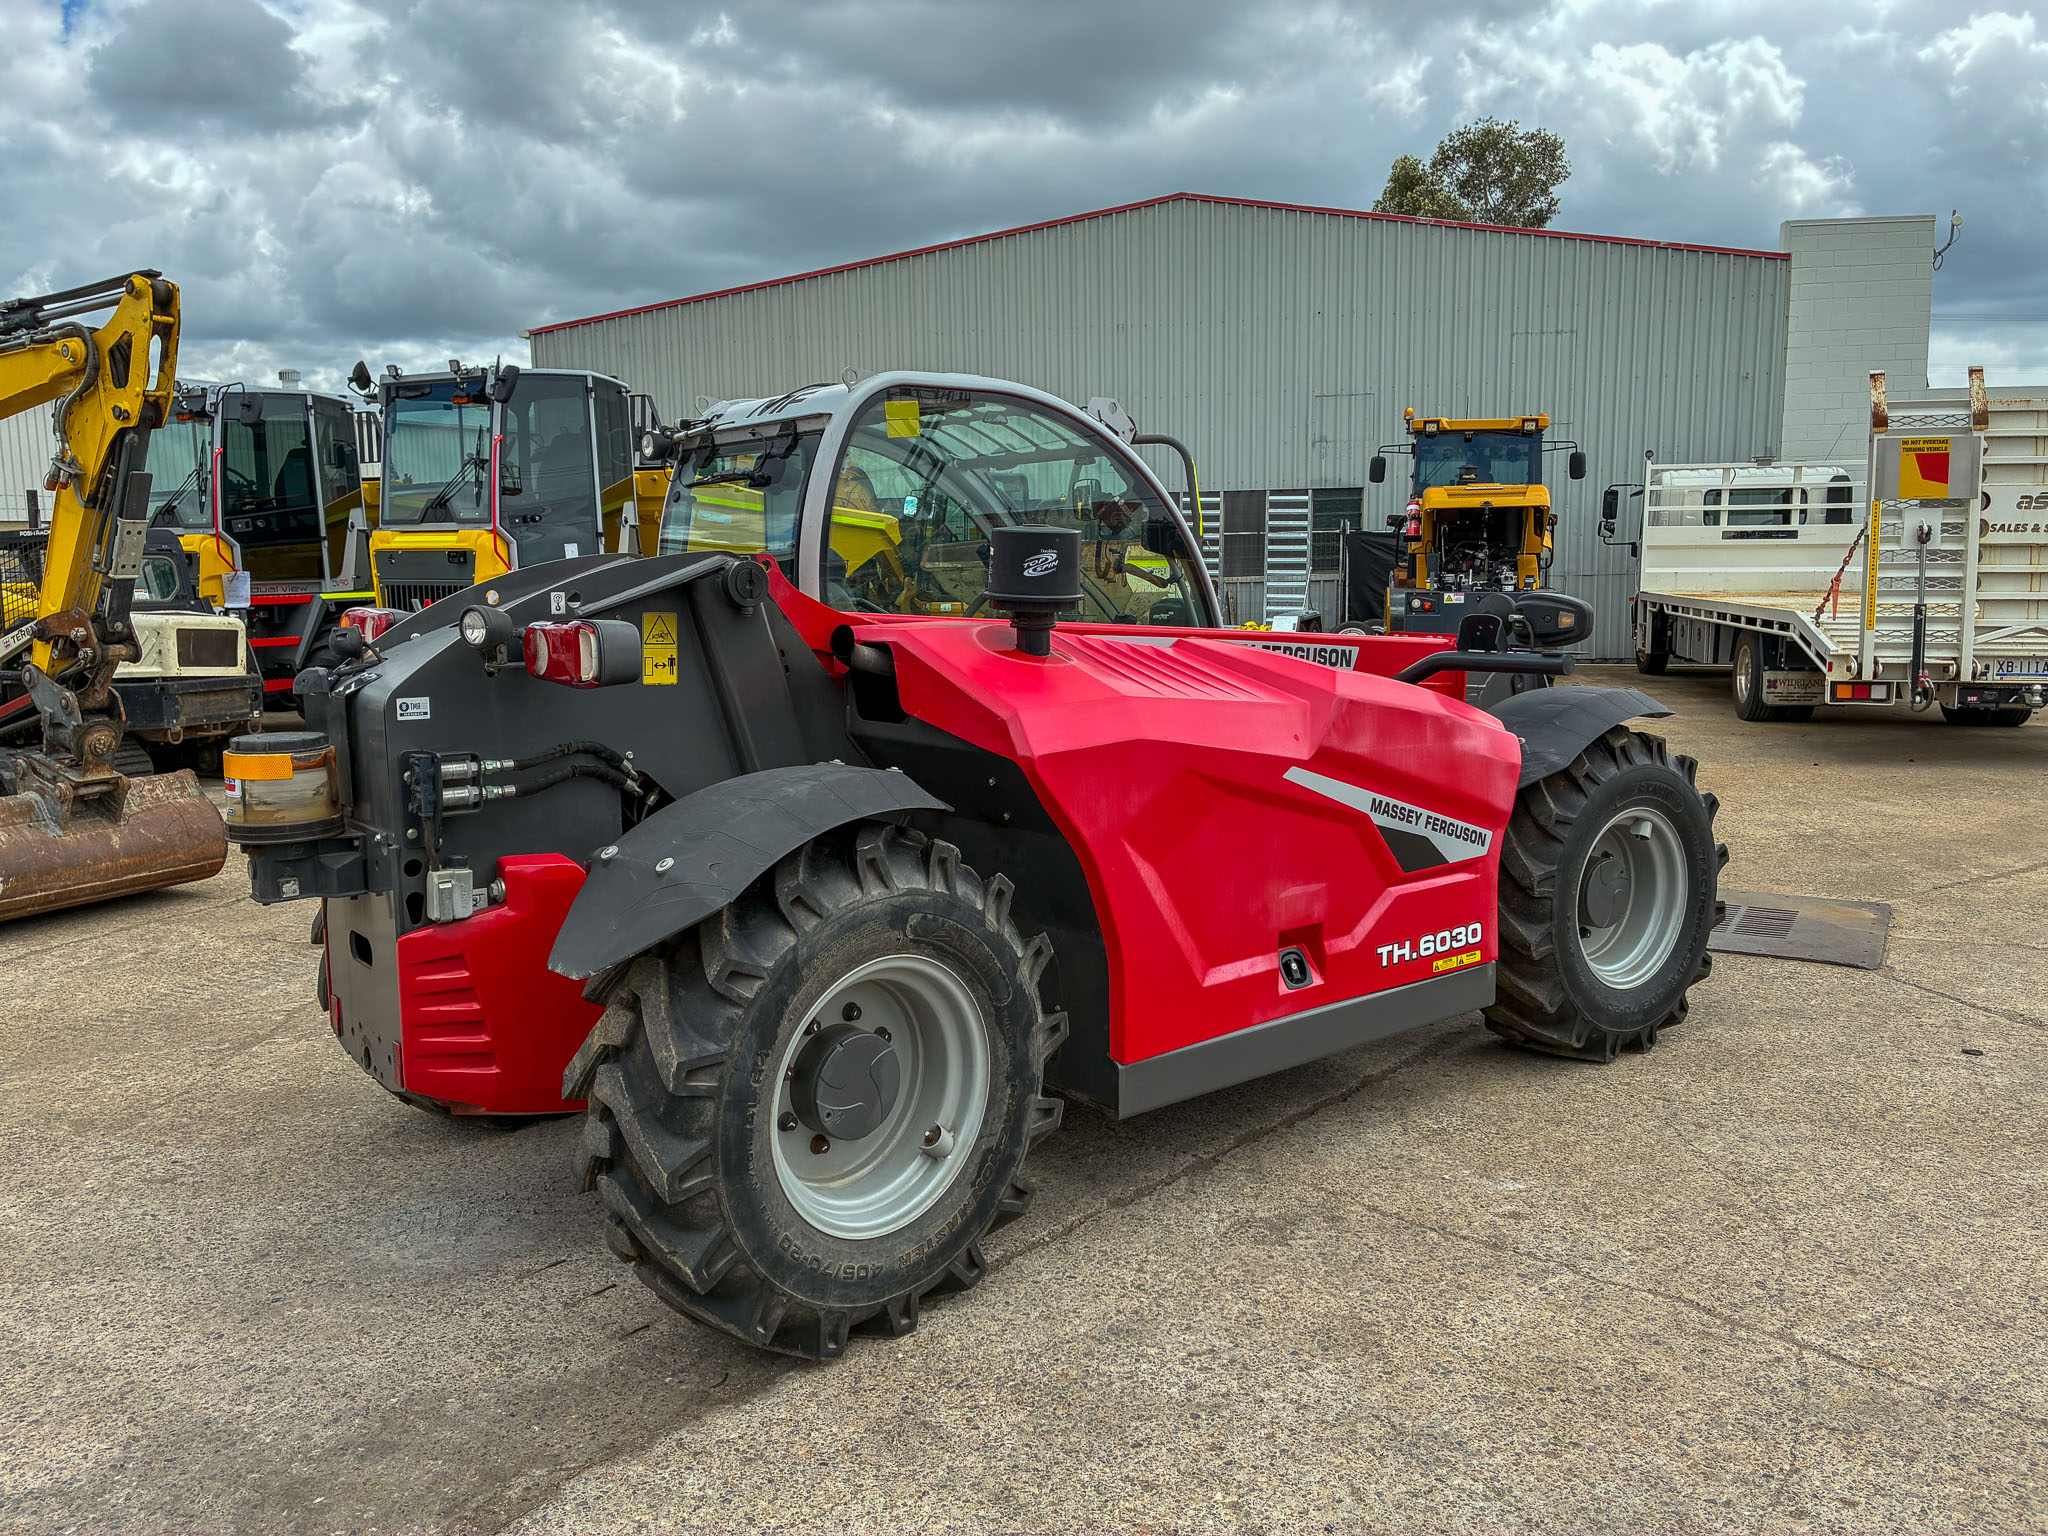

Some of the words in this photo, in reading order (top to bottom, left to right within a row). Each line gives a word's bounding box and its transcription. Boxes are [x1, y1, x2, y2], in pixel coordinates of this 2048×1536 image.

[1990, 523, 2028, 533] SALES
[2030, 523, 2040, 533] &
[1023, 557, 1046, 569] TOP
[1036, 560, 1059, 572] SPIN
[280, 585, 308, 593] view
[1370, 797, 1422, 826] MASSEY
[1424, 814, 1487, 847] FERGUSON
[1377, 922, 1482, 967] TH.6030
